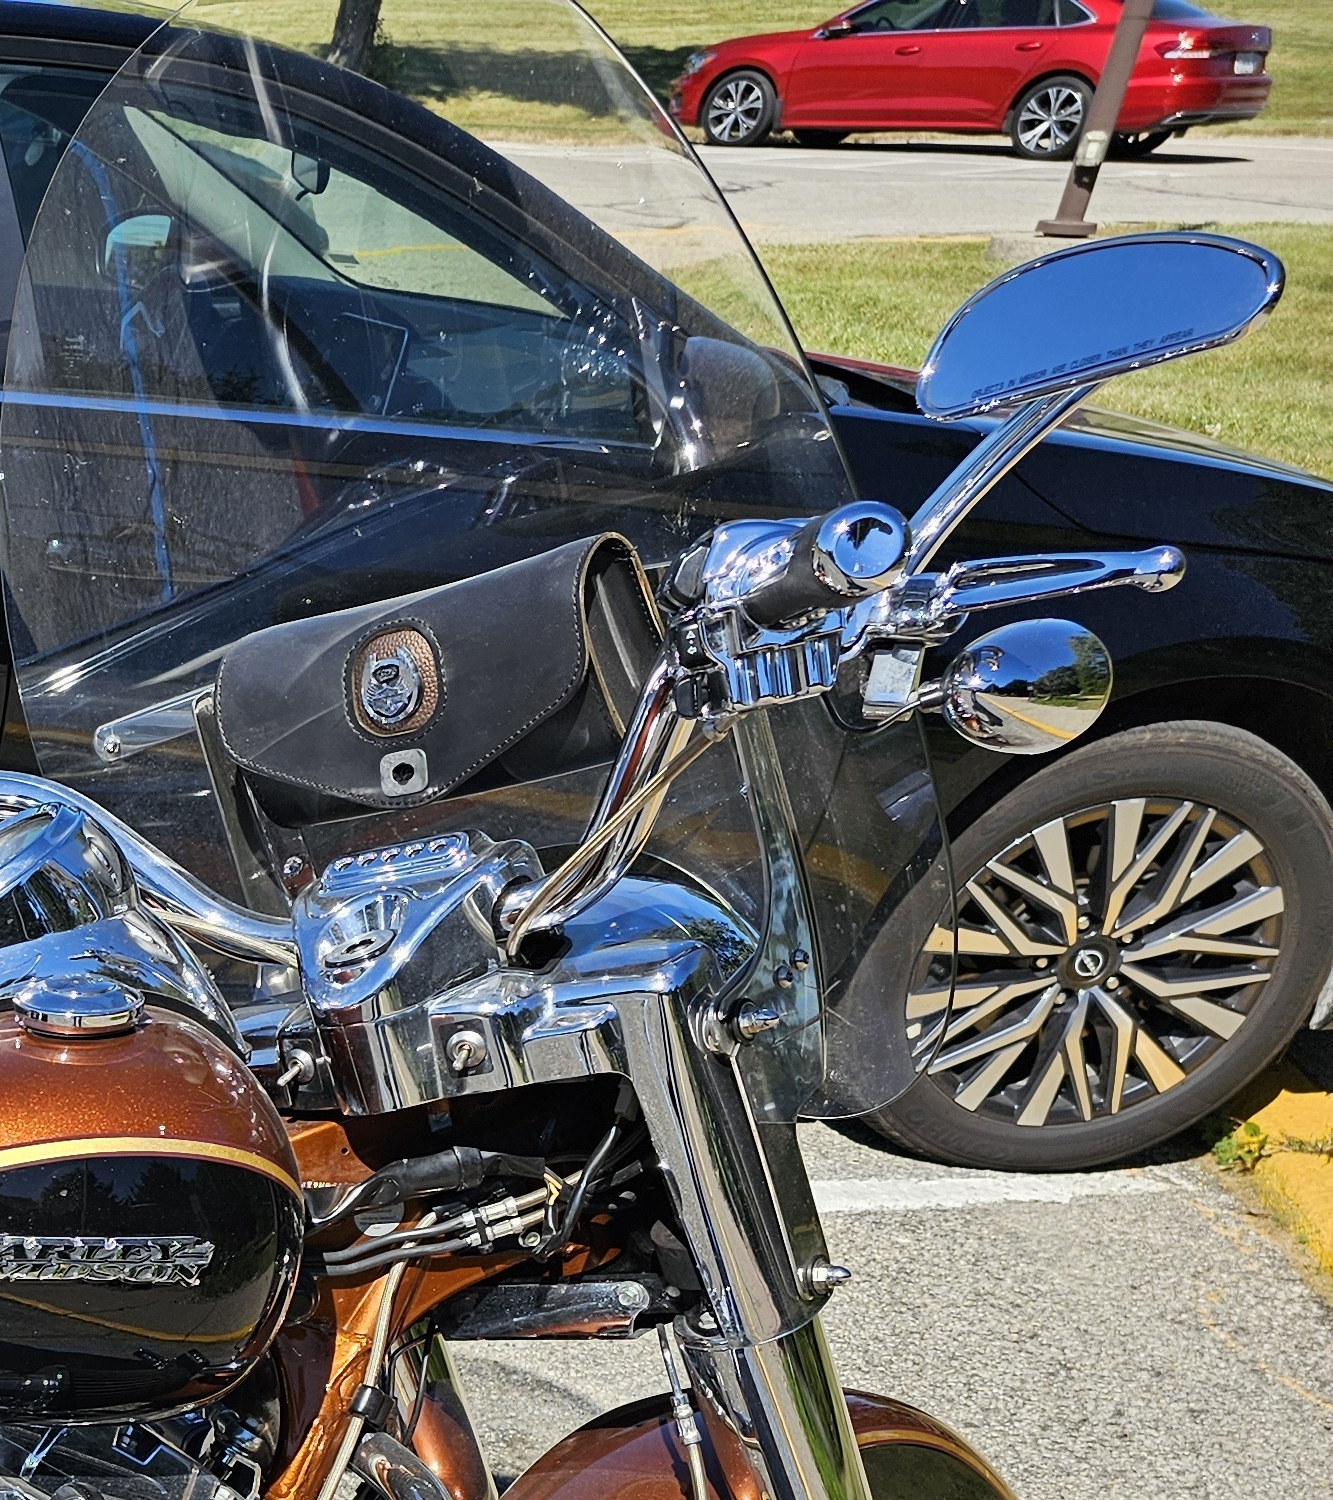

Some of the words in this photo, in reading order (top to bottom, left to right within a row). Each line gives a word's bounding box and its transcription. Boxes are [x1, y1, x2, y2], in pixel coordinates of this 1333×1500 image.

[971, 382, 1004, 399] OBJECTS
[1007, 379, 1016, 388] IN
[1019, 369, 1047, 384] MIRROR
[1051, 363, 1067, 374] ARE
[1069, 353, 1102, 369] CLOSER
[1106, 346, 1129, 359] THAN
[1132, 338, 1155, 351] THEY
[1159, 328, 1194, 344] APPEAR
